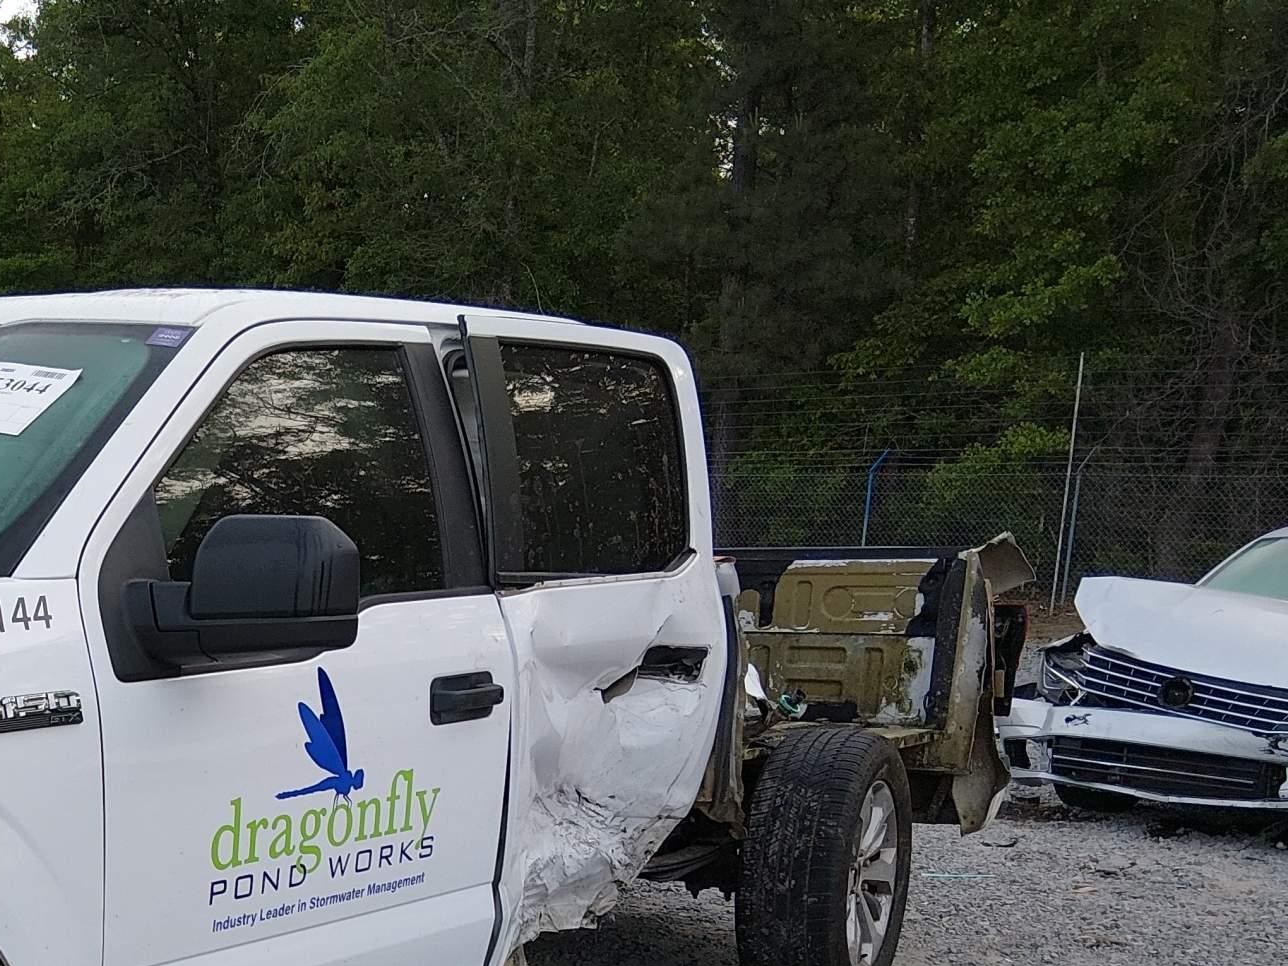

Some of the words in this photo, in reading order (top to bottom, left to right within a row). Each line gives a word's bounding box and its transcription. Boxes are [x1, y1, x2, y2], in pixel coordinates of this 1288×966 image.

[210, 768, 441, 874] dragonfly
[208, 863, 308, 906] POND
[328, 835, 435, 879] WORKS
[212, 911, 257, 932] Industry
[259, 902, 295, 922] Leader
[297, 900, 307, 913] in
[309, 887, 366, 910] Stormwater
[367, 872, 425, 897] Management
